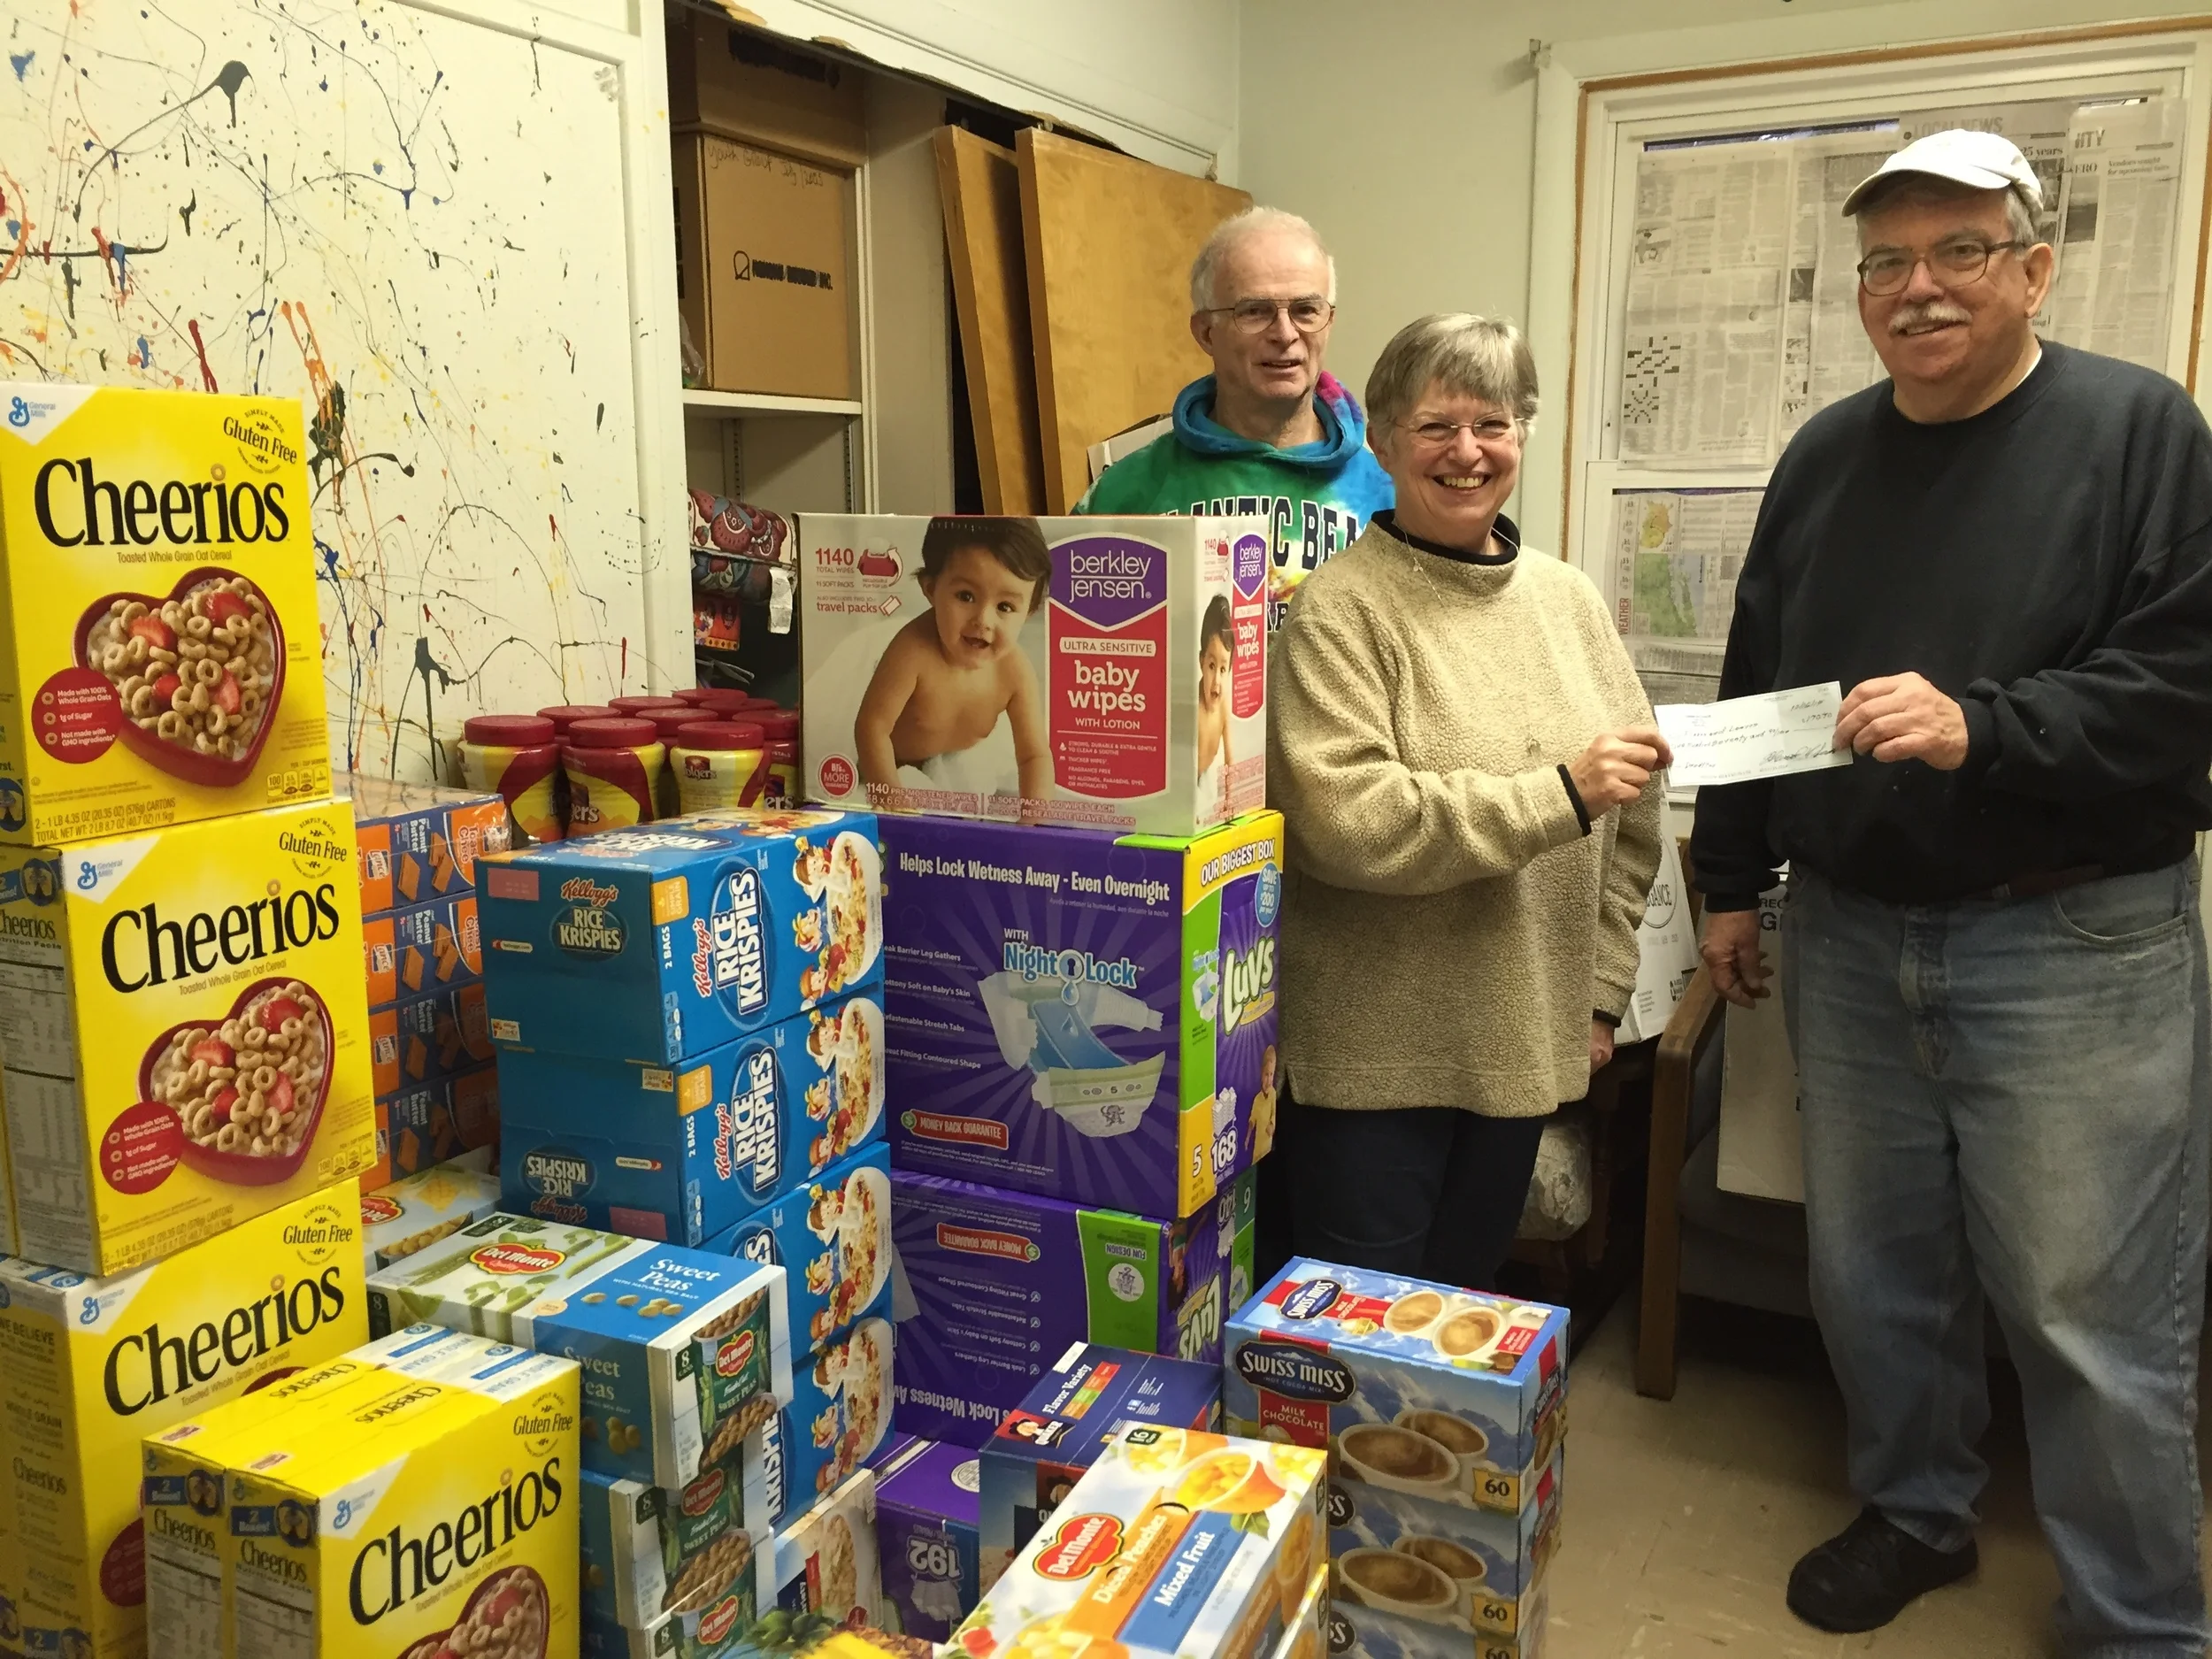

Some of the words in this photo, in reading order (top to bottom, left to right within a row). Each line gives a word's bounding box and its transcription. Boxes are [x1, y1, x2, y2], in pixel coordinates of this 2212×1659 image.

[2036, 147, 2063, 157] years
[29, 401, 56, 411] General
[223, 416, 269, 452] Gluten
[271, 437, 297, 465] Free
[35, 457, 289, 548] Cheerios
[117, 551, 147, 564] Toasted
[149, 550, 173, 562] Whole
[174, 550, 194, 562] Grain
[210, 549, 232, 561] Cereal
[815, 548, 854, 566] 1140
[1070, 549, 1152, 580] berkley
[817, 602, 845, 612] travel
[848, 603, 878, 614] packs
[1618, 597, 1631, 635] WEATHER
[1239, 622, 1258, 643] baby
[1064, 641, 1097, 651] ULTRA
[1100, 641, 1153, 654] SENSITIVE
[1237, 640, 1260, 660] wipes
[1074, 659, 1141, 692] baby
[1067, 684, 1147, 716] wipes
[74, 712, 93, 722] Sugar
[1075, 717, 1100, 727] WITH
[1102, 718, 1141, 730] LOTION
[823, 772, 850, 785] MORE
[866, 782, 890, 795] 1140
[53, 813, 64, 826] LB
[81, 811, 90, 823] OZ
[146, 797, 176, 812] CARTONS
[997, 795, 1018, 805] SOFT
[1064, 802, 1089, 811] WIPES
[1091, 803, 1115, 813] EACH
[1077, 812, 1105, 824] TRAVEL
[1106, 815, 1136, 826] PACKS
[36, 829, 58, 842] TOTAL
[60, 827, 74, 840] NET
[279, 831, 322, 857] Gluten
[323, 840, 348, 862] Free
[410, 819, 419, 853] Butter
[419, 818, 428, 854] Peanut
[1201, 860, 1220, 887] OUR
[1221, 841, 1258, 877] BIGGEST
[1258, 839, 1276, 862] BOX
[900, 852, 934, 877] Helps
[936, 856, 965, 879] Lock
[968, 859, 1023, 885] Wetness
[1025, 865, 1061, 893] Away
[1071, 871, 1102, 895] Even
[1104, 874, 1171, 906] Overnight
[1262, 868, 1279, 885] SAVE
[560, 877, 619, 907] Kellogg's
[415, 911, 424, 945] Butter
[424, 909, 433, 945] Peanut
[572, 908, 604, 929] RICE
[101, 883, 340, 994] Cheerios
[558, 924, 621, 951] KRISPIES
[661, 926, 673, 958] BAGS
[729, 870, 764, 1010] KRISPIES
[1004, 927, 1029, 941] WITH
[692, 917, 712, 999] Kellogg's
[712, 910, 741, 984] RICE
[896, 946, 919, 956] Barrier
[921, 949, 933, 959] Leg
[933, 951, 961, 962] Gathers
[1003, 941, 1058, 984] Night
[1085, 952, 1138, 989] Lock
[179, 979, 207, 996] Toasted
[208, 973, 232, 987] Whole
[233, 969, 252, 981] Grain
[907, 981, 922, 991] Soft
[933, 984, 955, 995] Baby's
[956, 987, 971, 997] Skin
[924, 1019, 949, 1030] Stretch
[949, 1023, 964, 1033] Tabs
[900, 1049, 922, 1060] Fitting
[923, 1053, 958, 1065] Contoured
[959, 1059, 981, 1070] Shape
[686, 1115, 696, 1148] BAGS
[733, 1094, 757, 1168] RICE
[750, 1050, 779, 1189] KRISPIES
[919, 1116, 943, 1131] MONEY
[944, 1121, 963, 1133] BACK
[963, 1122, 1002, 1140] GUARANTEE
[713, 1102, 733, 1181] Kellogg's
[1210, 1128, 1238, 1175] 168
[526, 1155, 588, 1184] KRISPIES
[1192, 1143, 1202, 1178] 5
[542, 1176, 572, 1197] RICE
[282, 1225, 326, 1245] Gluten
[328, 1224, 353, 1243] Free
[482, 1248, 508, 1260] Del
[509, 1251, 557, 1269] Monte
[1105, 1242, 1133, 1257] DESIGN
[1133, 1246, 1147, 1260] FUN
[638, 1271, 694, 1292] Peas
[649, 1258, 721, 1282] Sweet
[632, 1282, 663, 1294] NATURAL
[104, 1266, 345, 1417] Cheerios
[728, 1338, 752, 1361] Monte
[564, 1346, 621, 1378] Sweet
[680, 1348, 691, 1367] 8
[269, 1363, 357, 1398] Cheerios
[1041, 1387, 1071, 1414] Flavor
[1061, 1363, 1094, 1390] Variety
[1281, 1379, 1307, 1392] COCOA
[355, 1386, 442, 1425] Cheerios
[718, 1392, 741, 1413] SWEET
[910, 1387, 966, 1417] Wetness
[968, 1401, 999, 1425] Lock
[1280, 1404, 1306, 1417] MILK
[513, 1415, 551, 1436] Gluten
[552, 1412, 573, 1432] Free
[1262, 1409, 1325, 1432] CHOCOLATE
[1129, 1431, 1150, 1443] 16
[12, 1456, 67, 1495] Cheerios
[1484, 1478, 1510, 1498] 60
[642, 1493, 652, 1510] 8
[154, 1508, 216, 1550] Cheerios
[1064, 1516, 1107, 1557] Monte
[349, 1457, 563, 1627] Cheerios
[683, 1532, 710, 1552] SWEET
[241, 1538, 307, 1583] Cheerios
[908, 1539, 962, 1579] 192
[1153, 1560, 1195, 1608] Mixed
[1182, 1530, 1216, 1563] Fruit
[1482, 1603, 1509, 1623] 60
